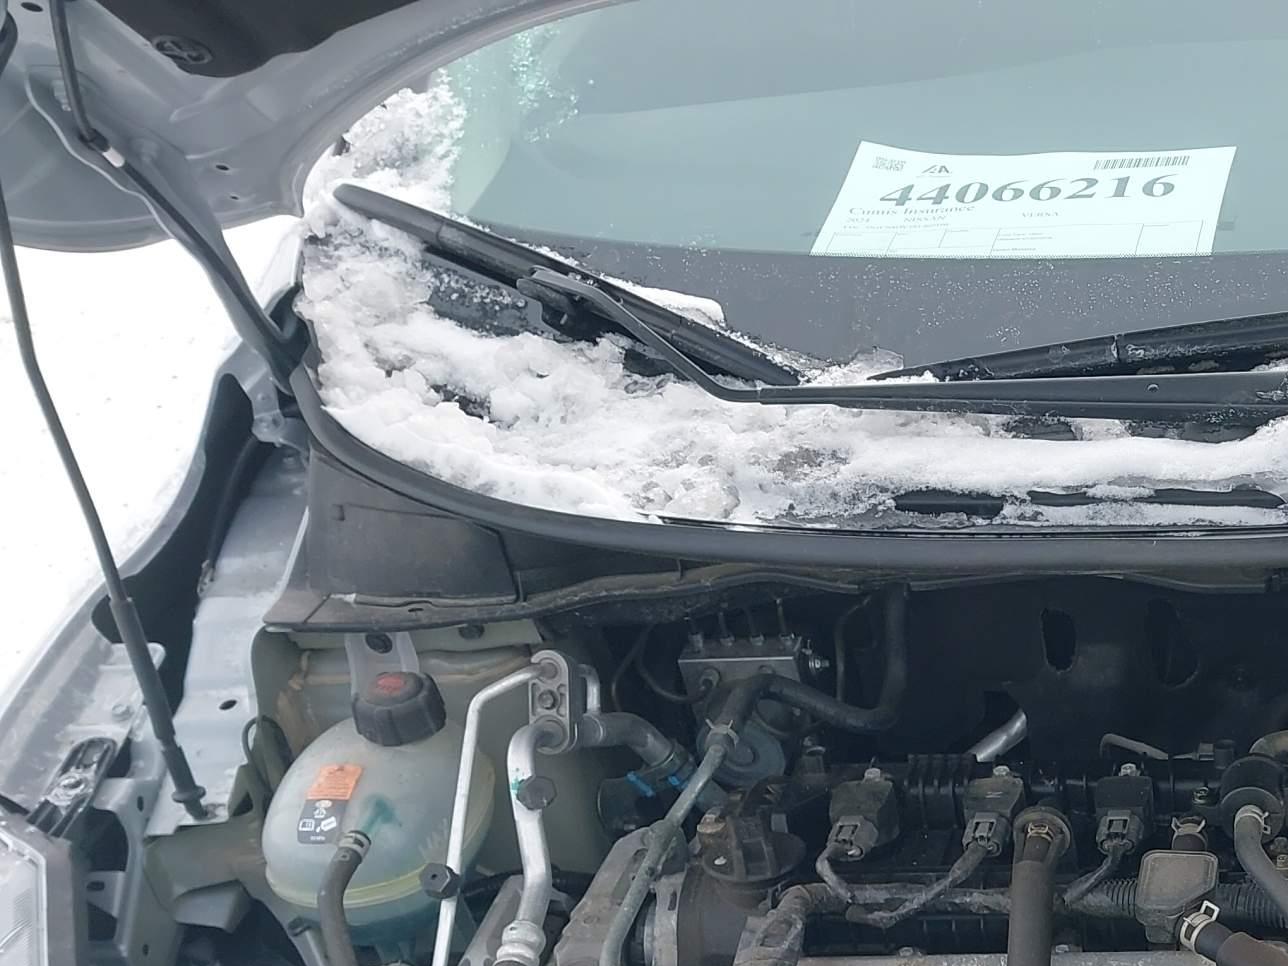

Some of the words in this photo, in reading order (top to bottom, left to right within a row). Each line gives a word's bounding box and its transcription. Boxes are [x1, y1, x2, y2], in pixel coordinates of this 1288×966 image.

[879, 172, 1178, 207] 44066216
[903, 204, 976, 215] Insurance
[904, 215, 947, 223] NISSAN
